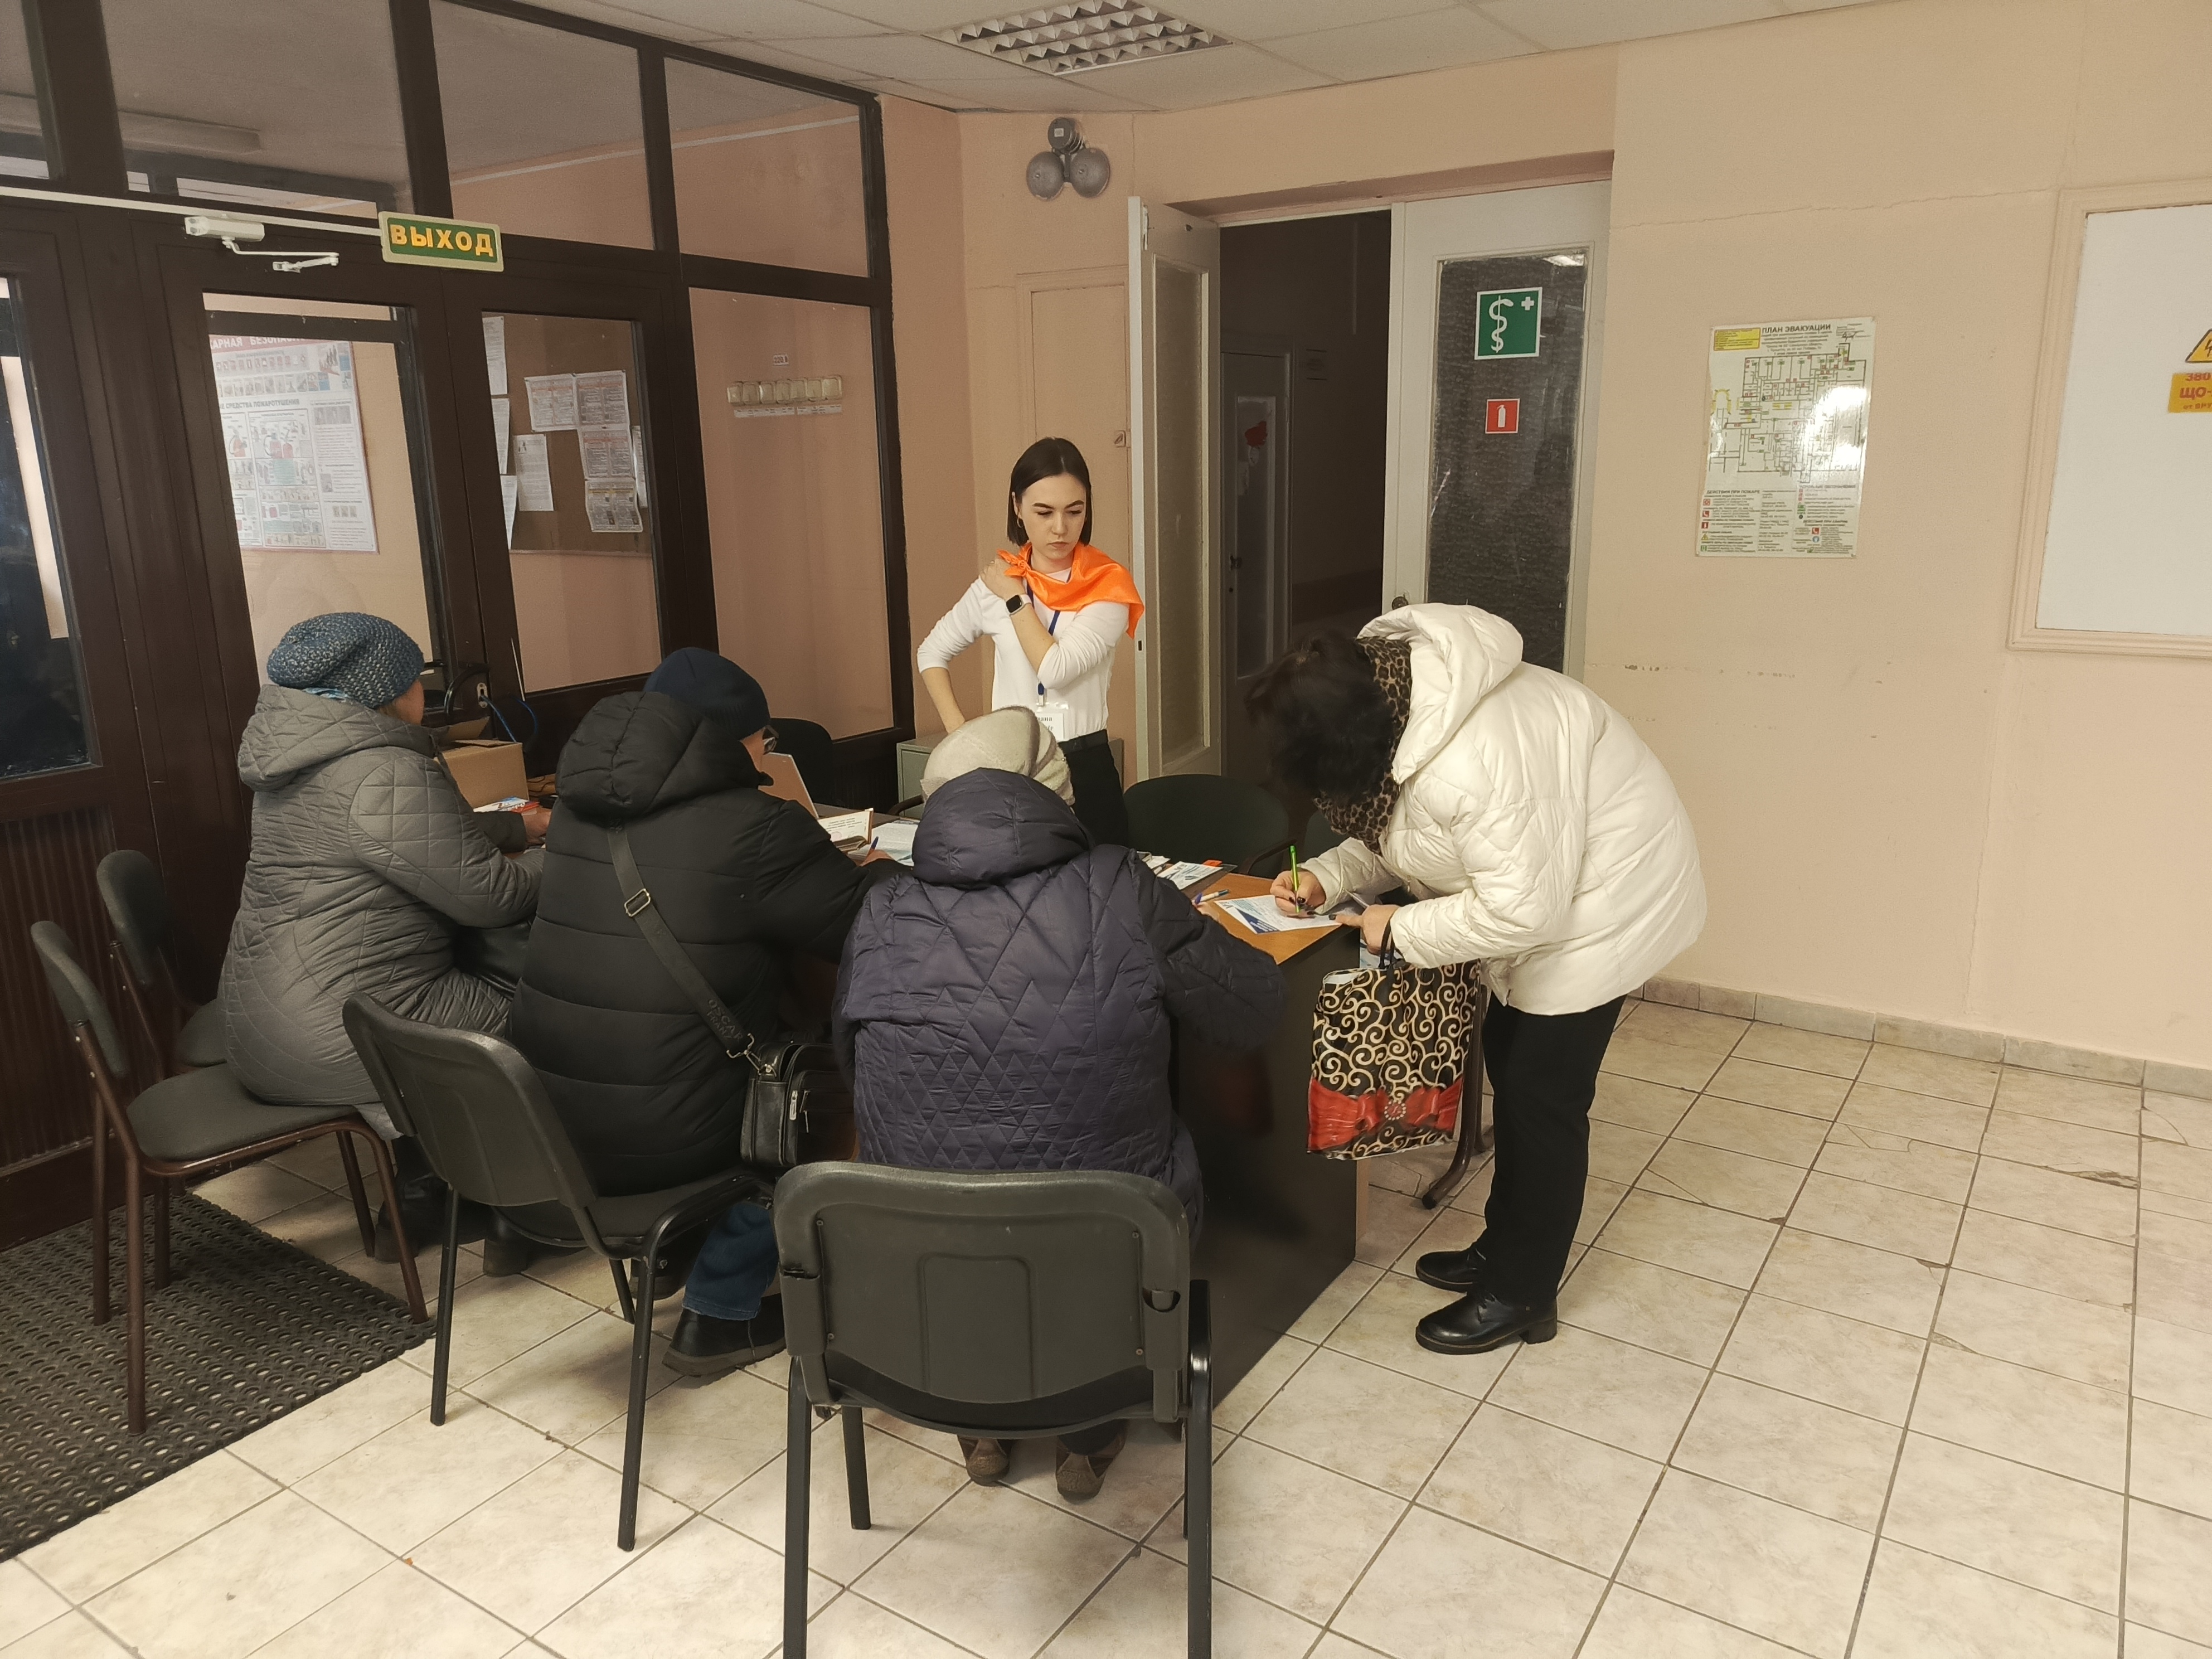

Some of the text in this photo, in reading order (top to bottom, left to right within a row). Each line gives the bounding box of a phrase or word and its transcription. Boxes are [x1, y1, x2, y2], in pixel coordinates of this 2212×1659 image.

[390, 224, 494, 258] ВЫХОД
[1785, 324, 1831, 332] ЭВАКУАЦИИ
[2179, 386, 2212, 400] ЩО-
